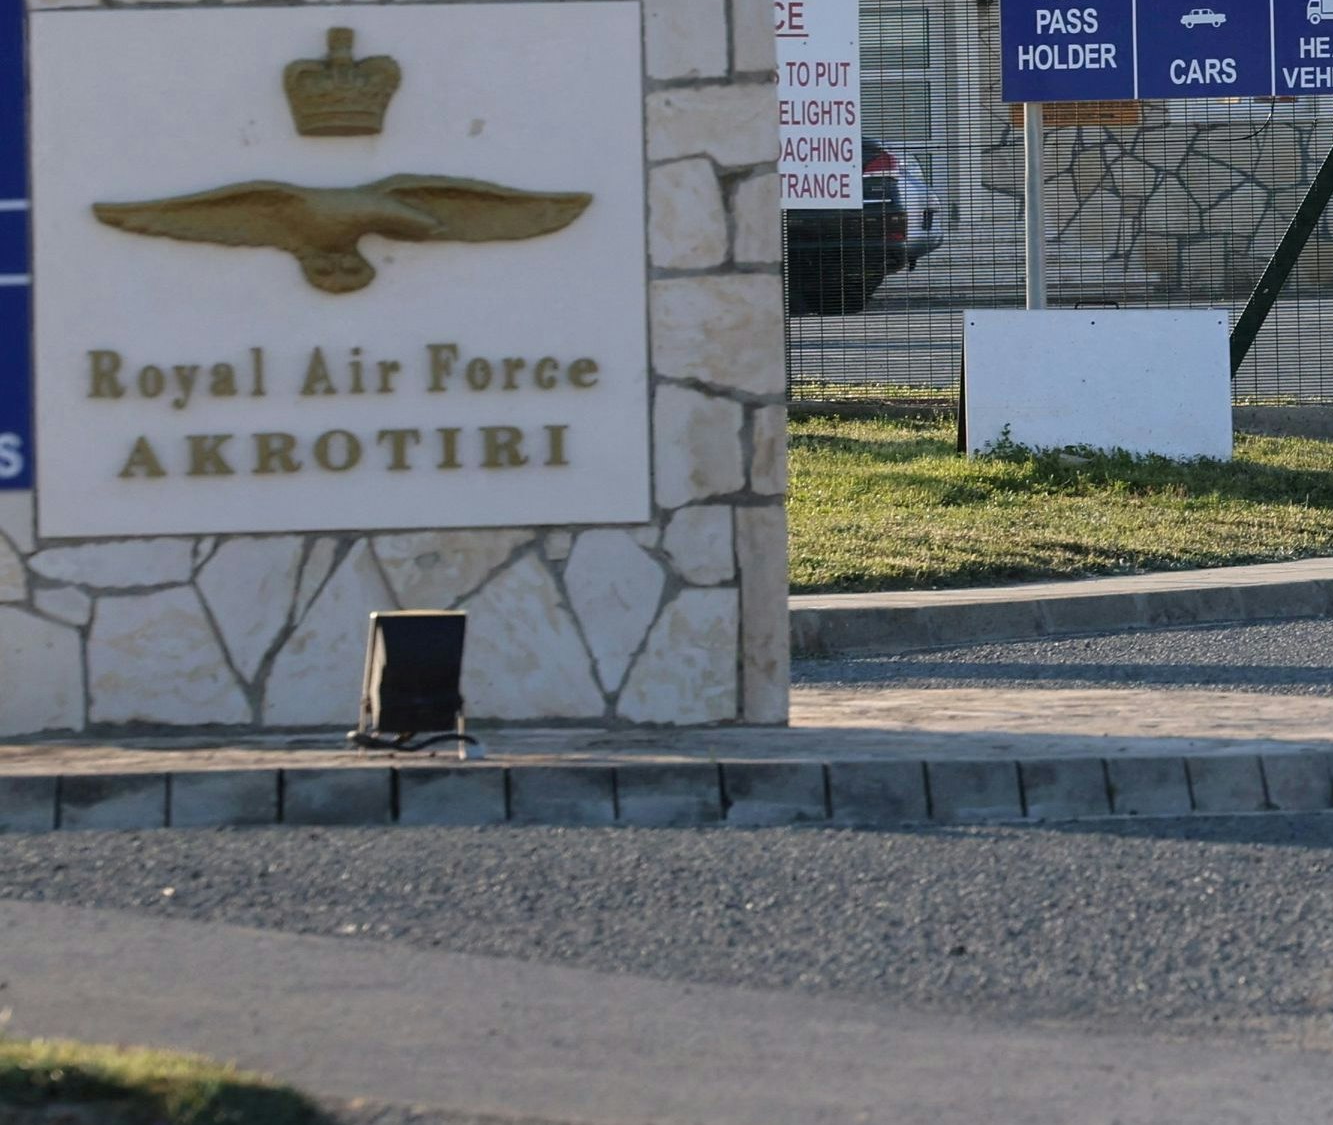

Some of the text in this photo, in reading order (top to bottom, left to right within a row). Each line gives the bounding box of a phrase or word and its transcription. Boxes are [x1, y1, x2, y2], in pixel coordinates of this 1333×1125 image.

[1036, 8, 1099, 35] PASS
[1018, 44, 1117, 71] HOLDER
[786, 62, 809, 87] TO
[816, 62, 850, 87] PUT
[1170, 59, 1237, 85] CARS
[87, 343, 600, 409] Royal Air Force
[117, 424, 571, 478] AKROTIRI
